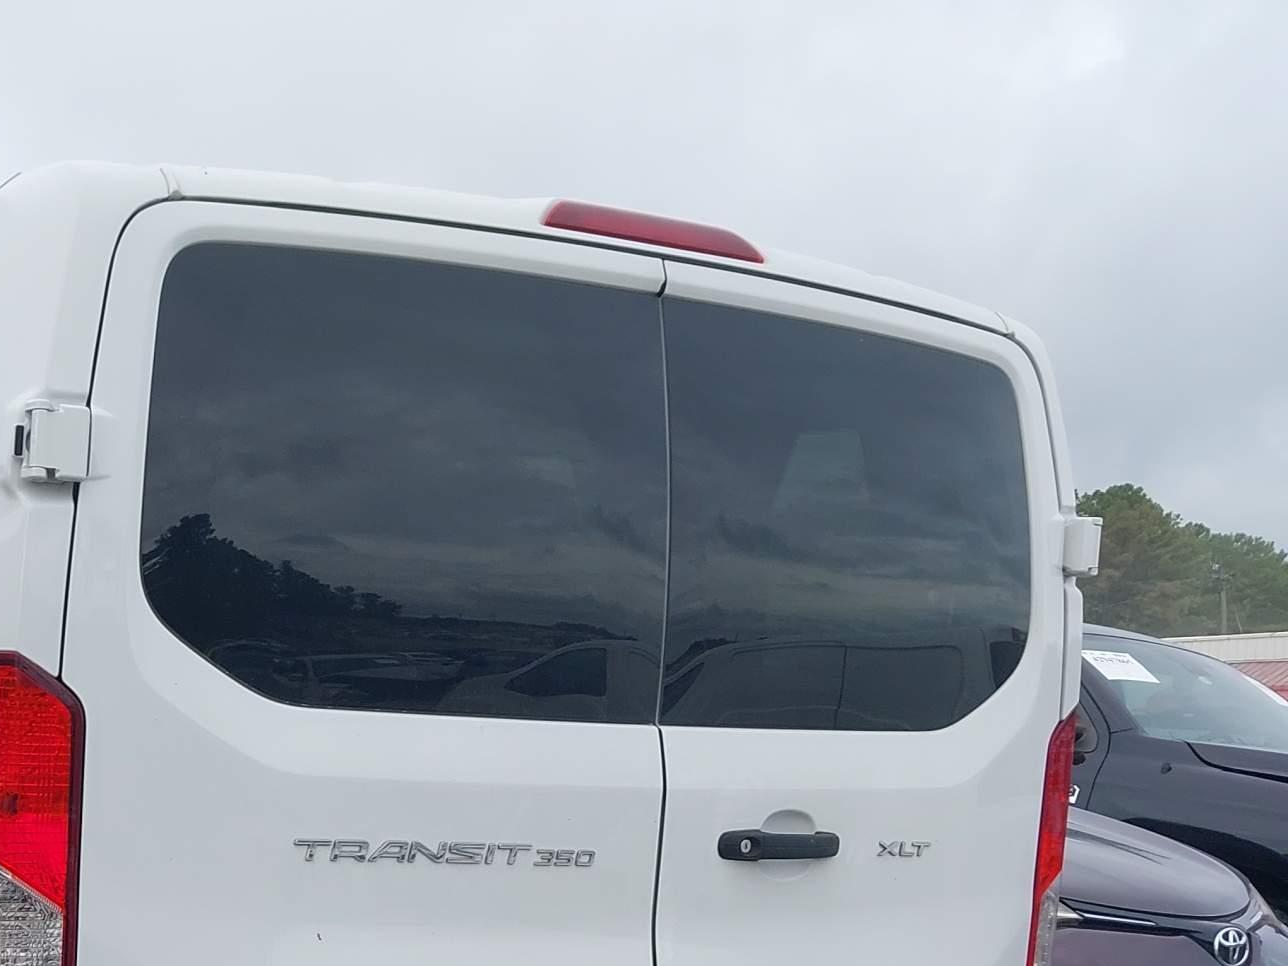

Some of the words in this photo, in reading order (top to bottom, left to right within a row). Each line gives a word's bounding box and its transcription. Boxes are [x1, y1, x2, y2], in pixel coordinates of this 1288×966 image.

[293, 839, 532, 865] TRANSIT
[533, 848, 597, 868] 350
[877, 840, 931, 858] XLT
